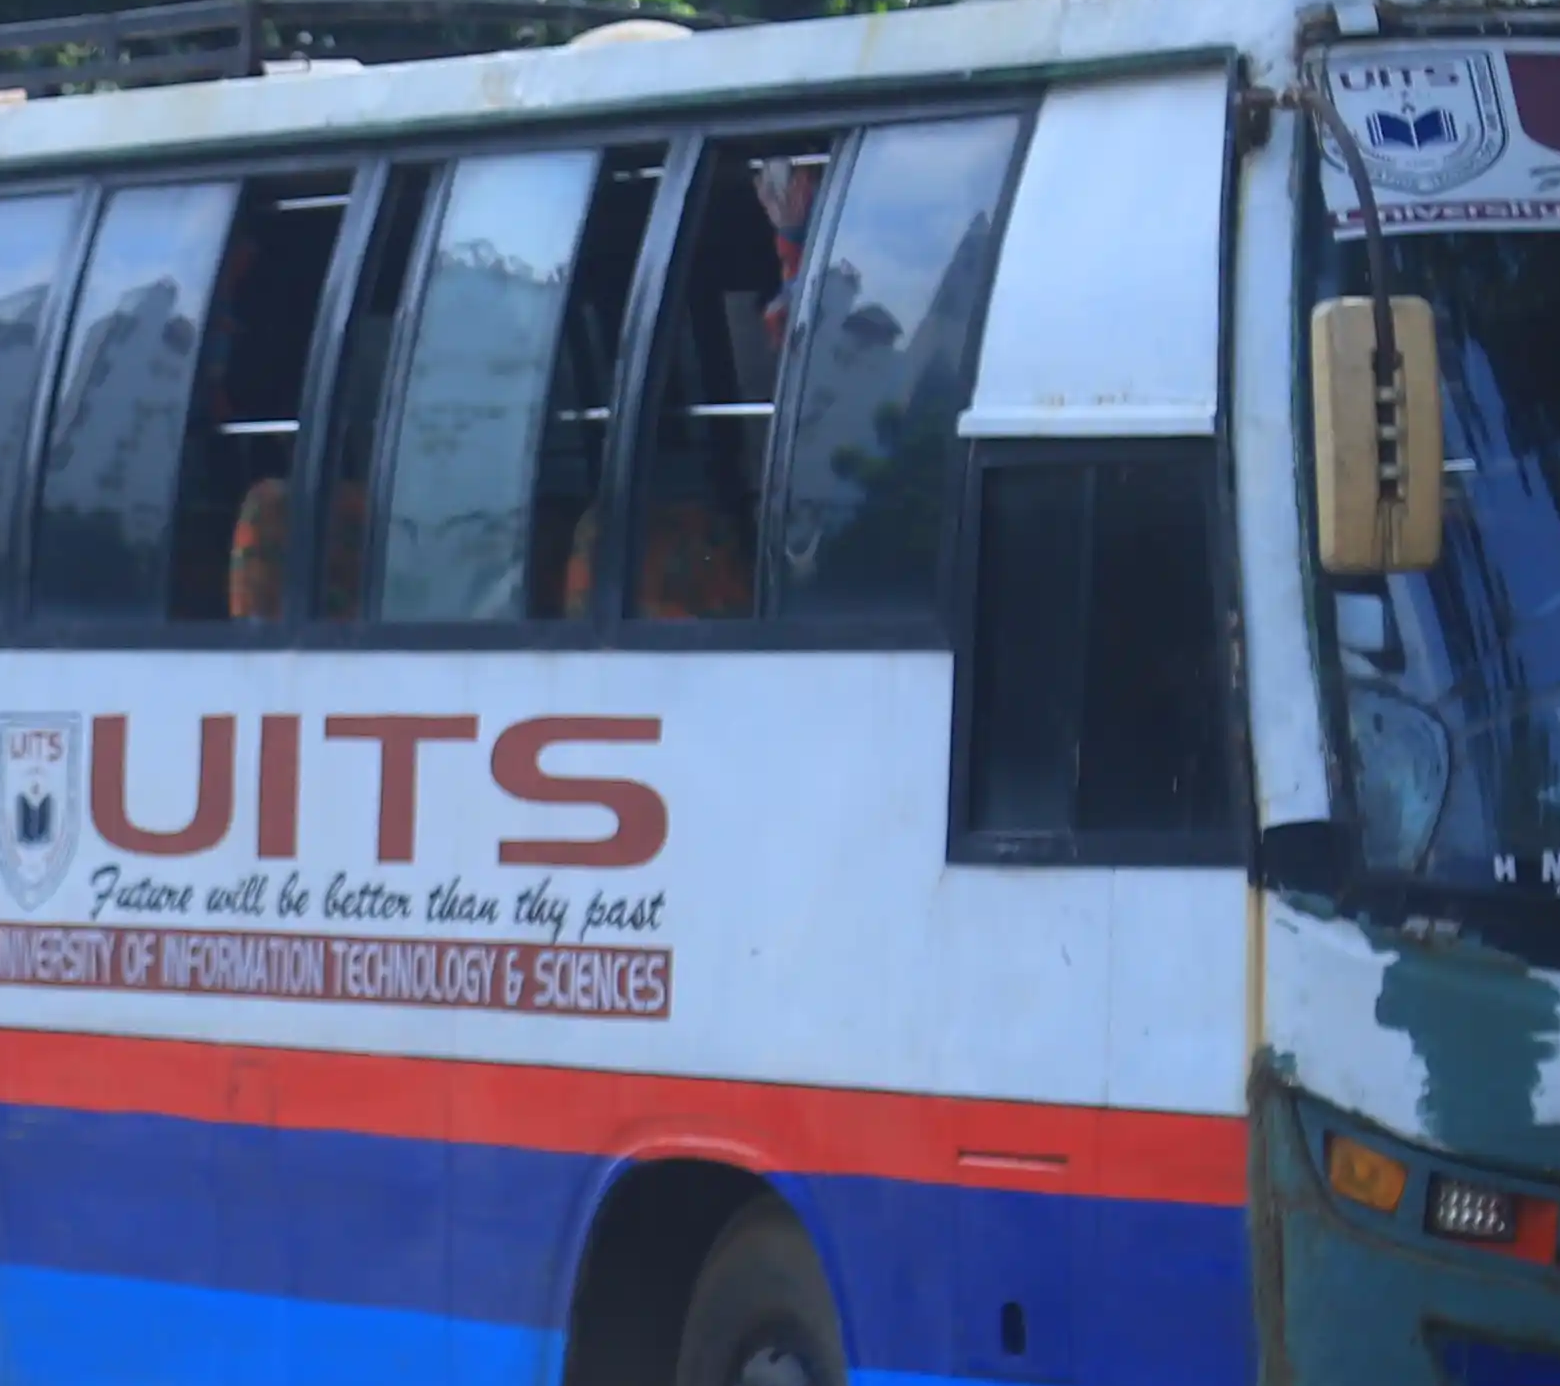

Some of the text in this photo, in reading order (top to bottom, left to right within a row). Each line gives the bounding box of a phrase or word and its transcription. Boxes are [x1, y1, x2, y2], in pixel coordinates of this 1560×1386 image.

[9, 729, 65, 763] UITS
[90, 713, 670, 869] UITS
[90, 863, 667, 946] Future will be better than thy past
[120, 931, 158, 987] OF
[161, 931, 326, 997] INFORMATION
[330, 940, 498, 1006] TECHNOLOGY
[503, 947, 525, 1006] &
[532, 948, 667, 1013] SCIENCES
